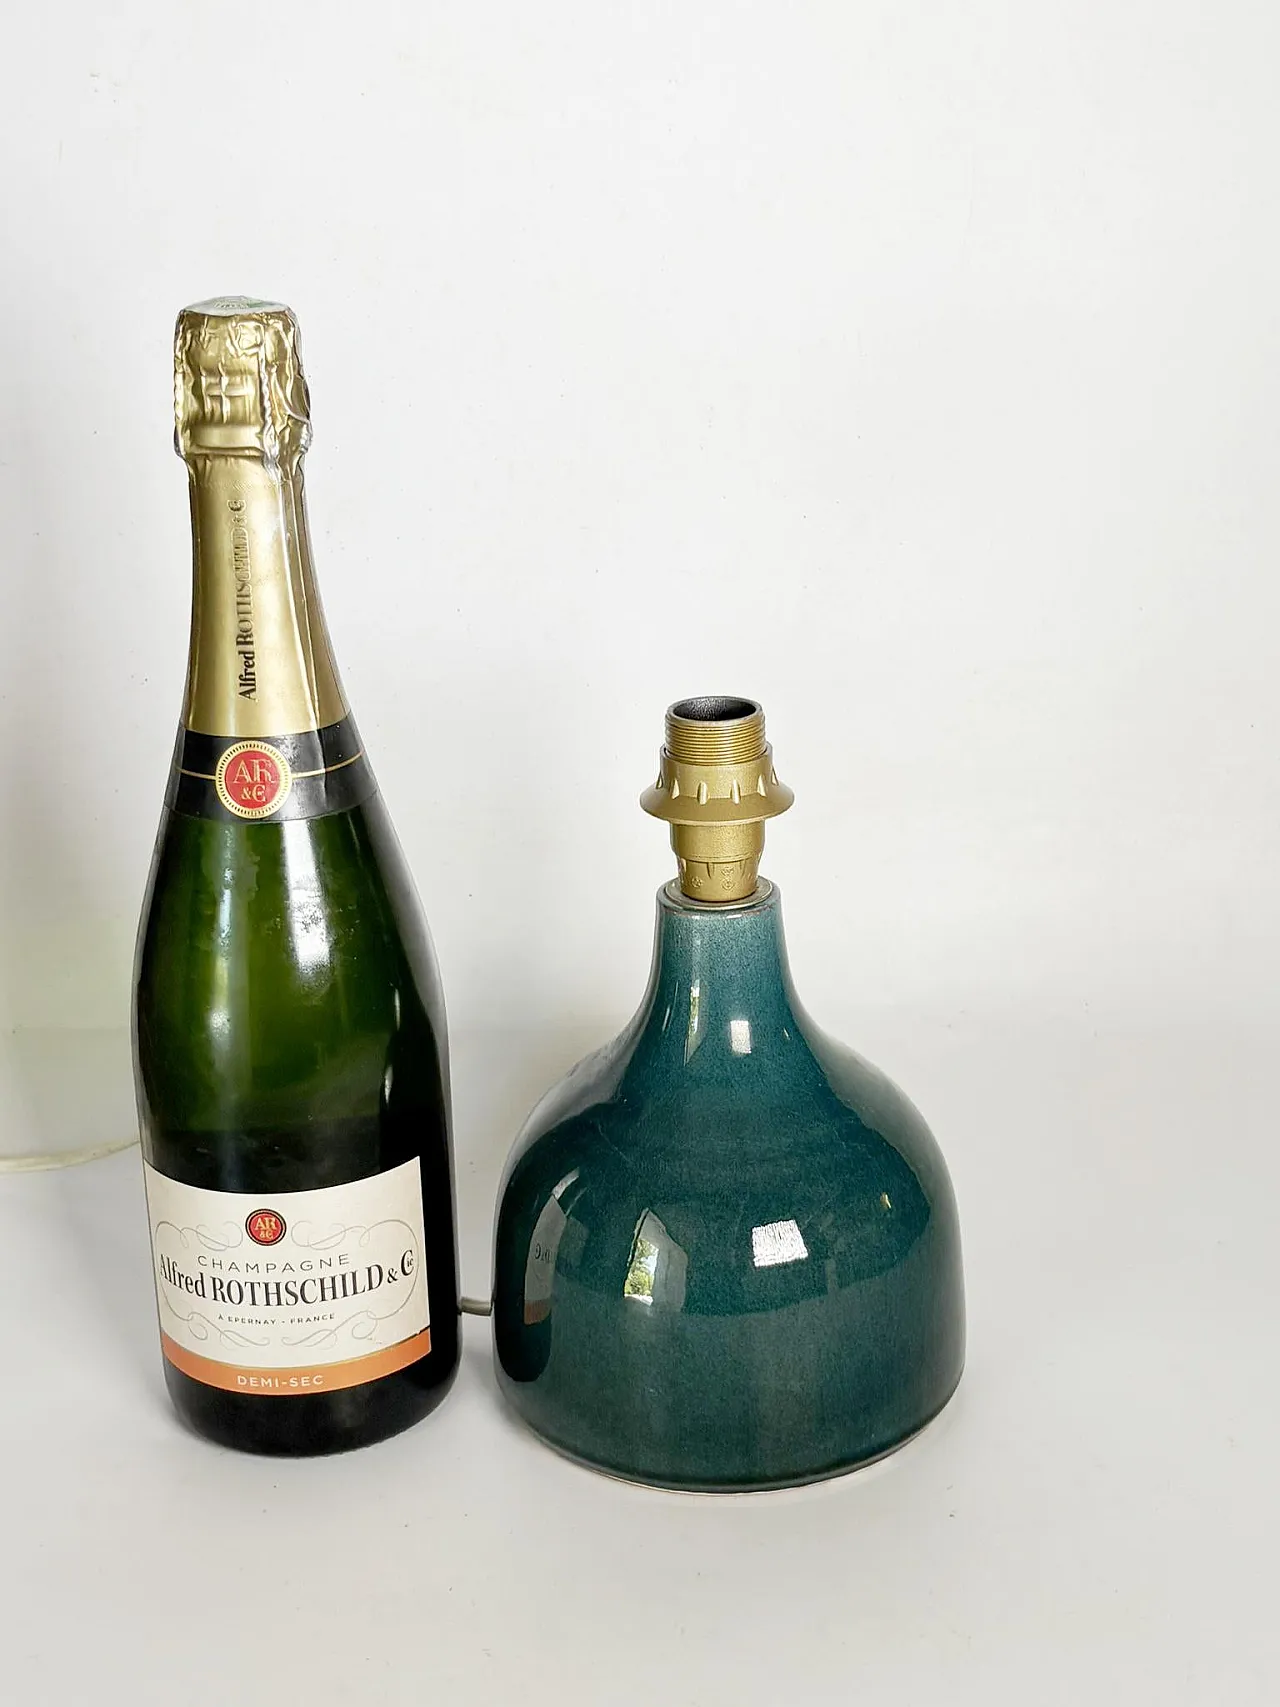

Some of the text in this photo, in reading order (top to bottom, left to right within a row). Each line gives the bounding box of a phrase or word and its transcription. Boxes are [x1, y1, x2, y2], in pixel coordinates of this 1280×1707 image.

[237, 652, 257, 701] Alfred
[197, 1253, 351, 1274] CHAMPAGNE
[159, 1253, 206, 1299] Alfred
[210, 1263, 384, 1307] ROTHSCHILD
[387, 1267, 399, 1284] &
[290, 1312, 335, 1324] FRANCE
[236, 1374, 325, 1388] DEMI-SEC
